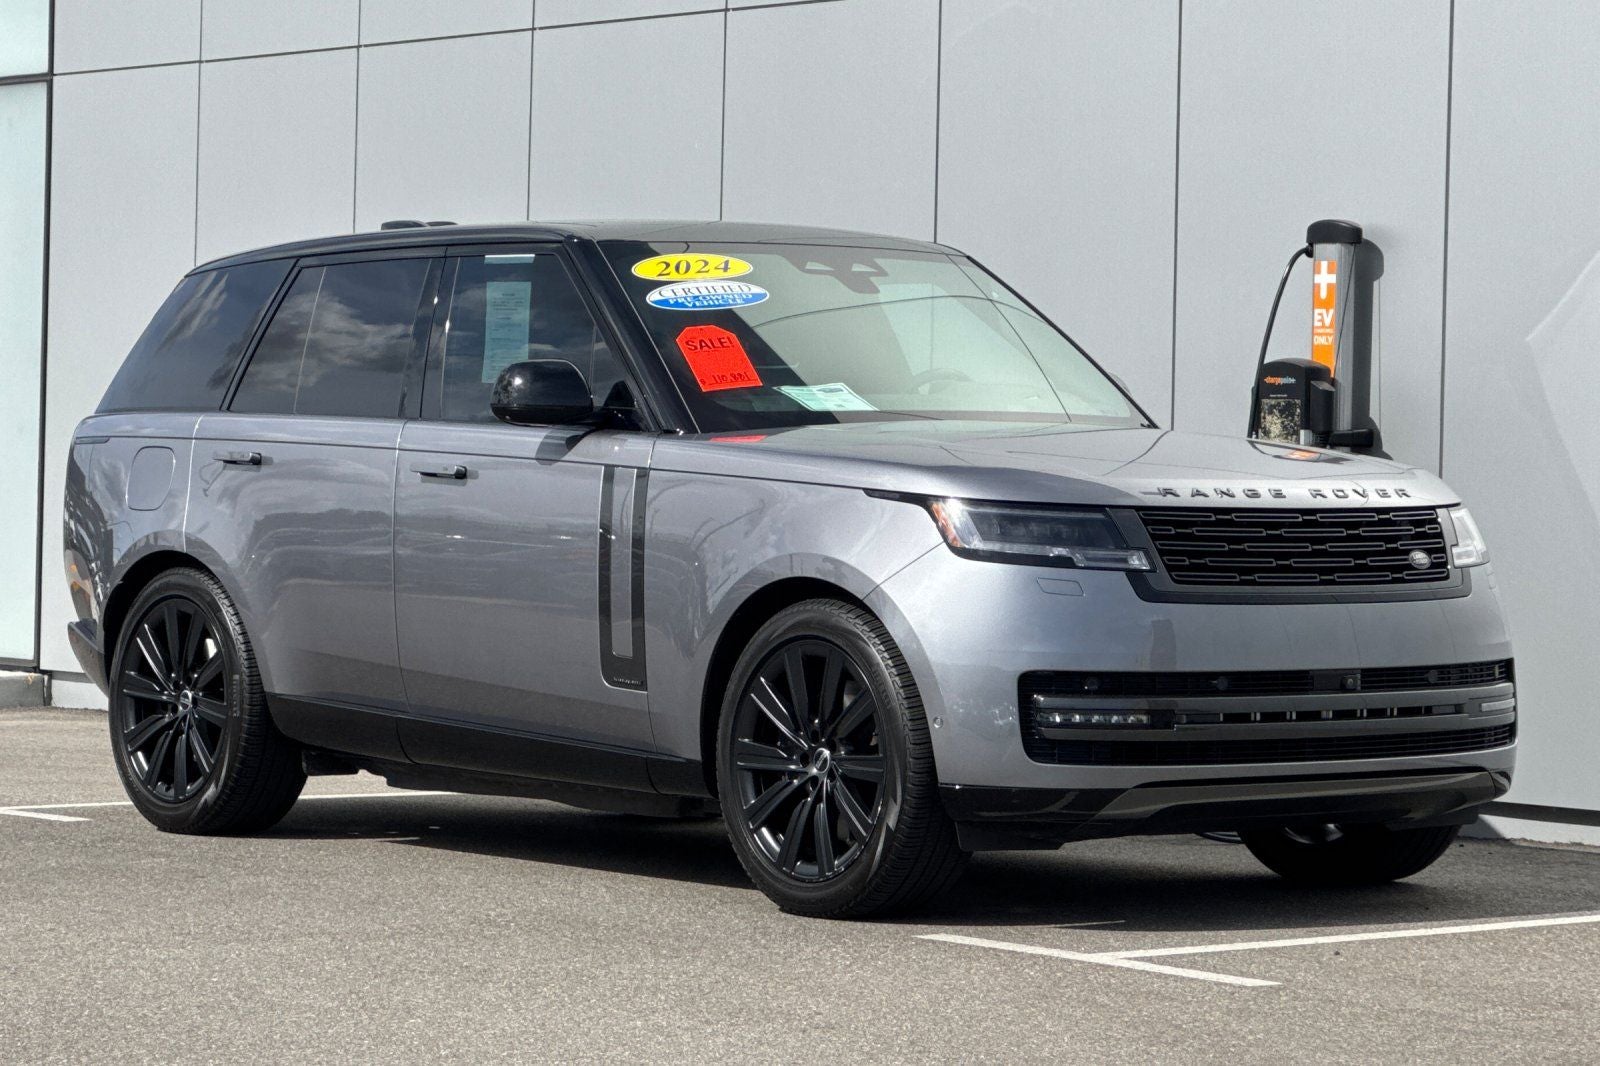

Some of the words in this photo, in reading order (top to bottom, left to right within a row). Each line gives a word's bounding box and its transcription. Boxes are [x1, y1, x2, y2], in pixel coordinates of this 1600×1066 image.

[656, 259, 731, 277] 2024
[659, 284, 752, 297] CERTIFIED
[668, 293, 753, 304] PRE-OWNED
[685, 298, 745, 307] VEHICLE
[1314, 309, 1334, 326] EV
[685, 336, 735, 351] SALE!
[1314, 335, 1334, 345] ONLY
[1156, 487, 1288, 499] RANGE
[1309, 487, 1412, 499] ROVER
